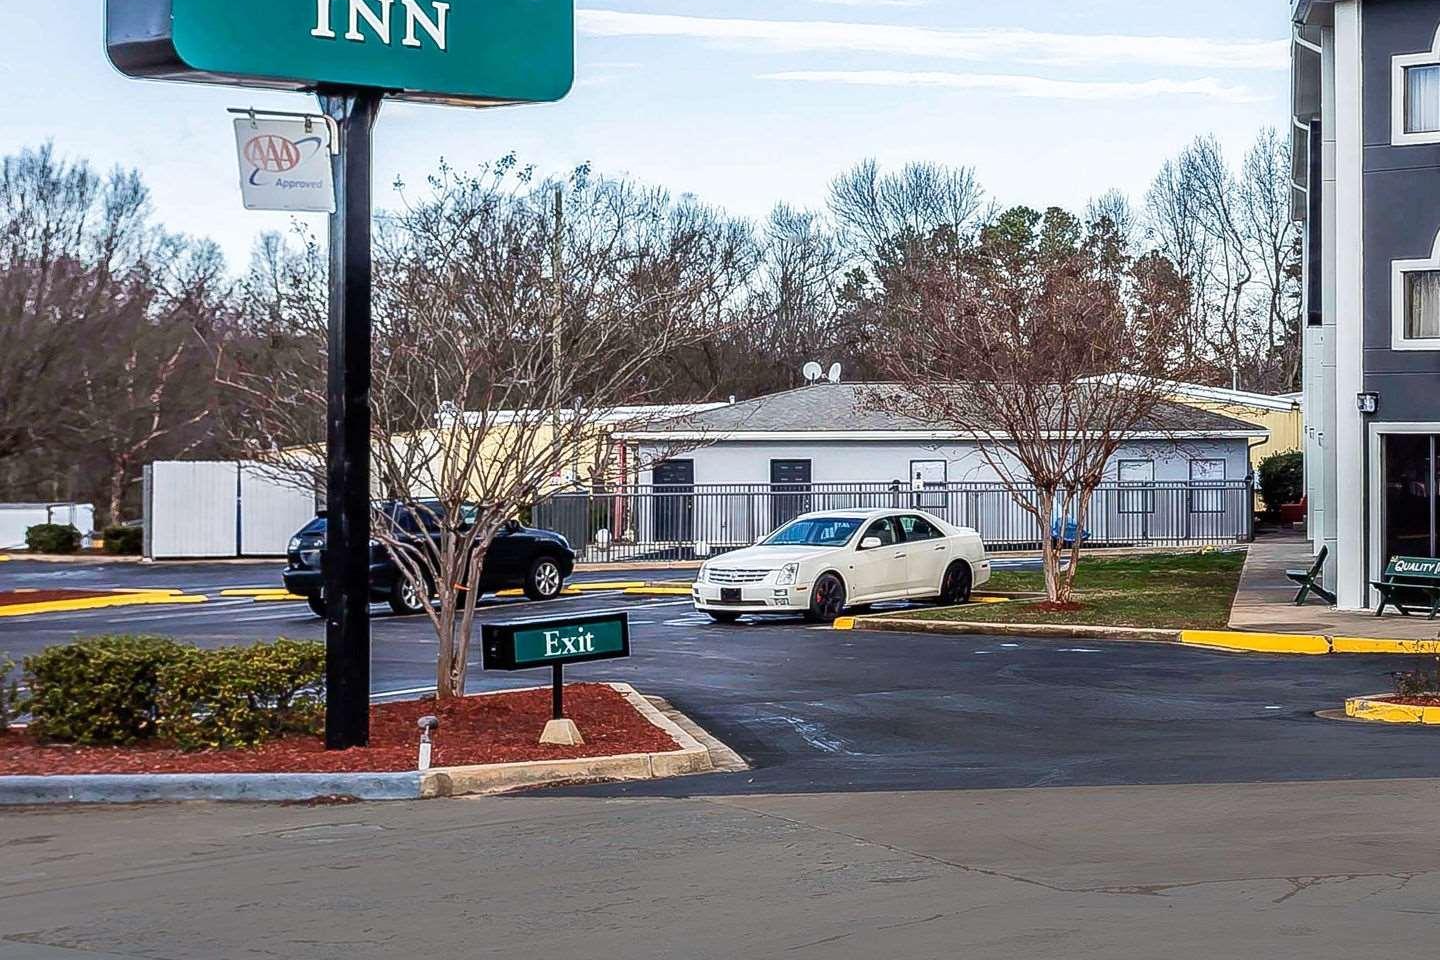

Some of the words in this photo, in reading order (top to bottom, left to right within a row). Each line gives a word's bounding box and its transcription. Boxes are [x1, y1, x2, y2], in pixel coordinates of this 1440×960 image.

[250, 135, 295, 171] AAA
[275, 178, 323, 190] Approved
[1394, 560, 1435, 573] QUALITY
[543, 626, 595, 657] Exit
